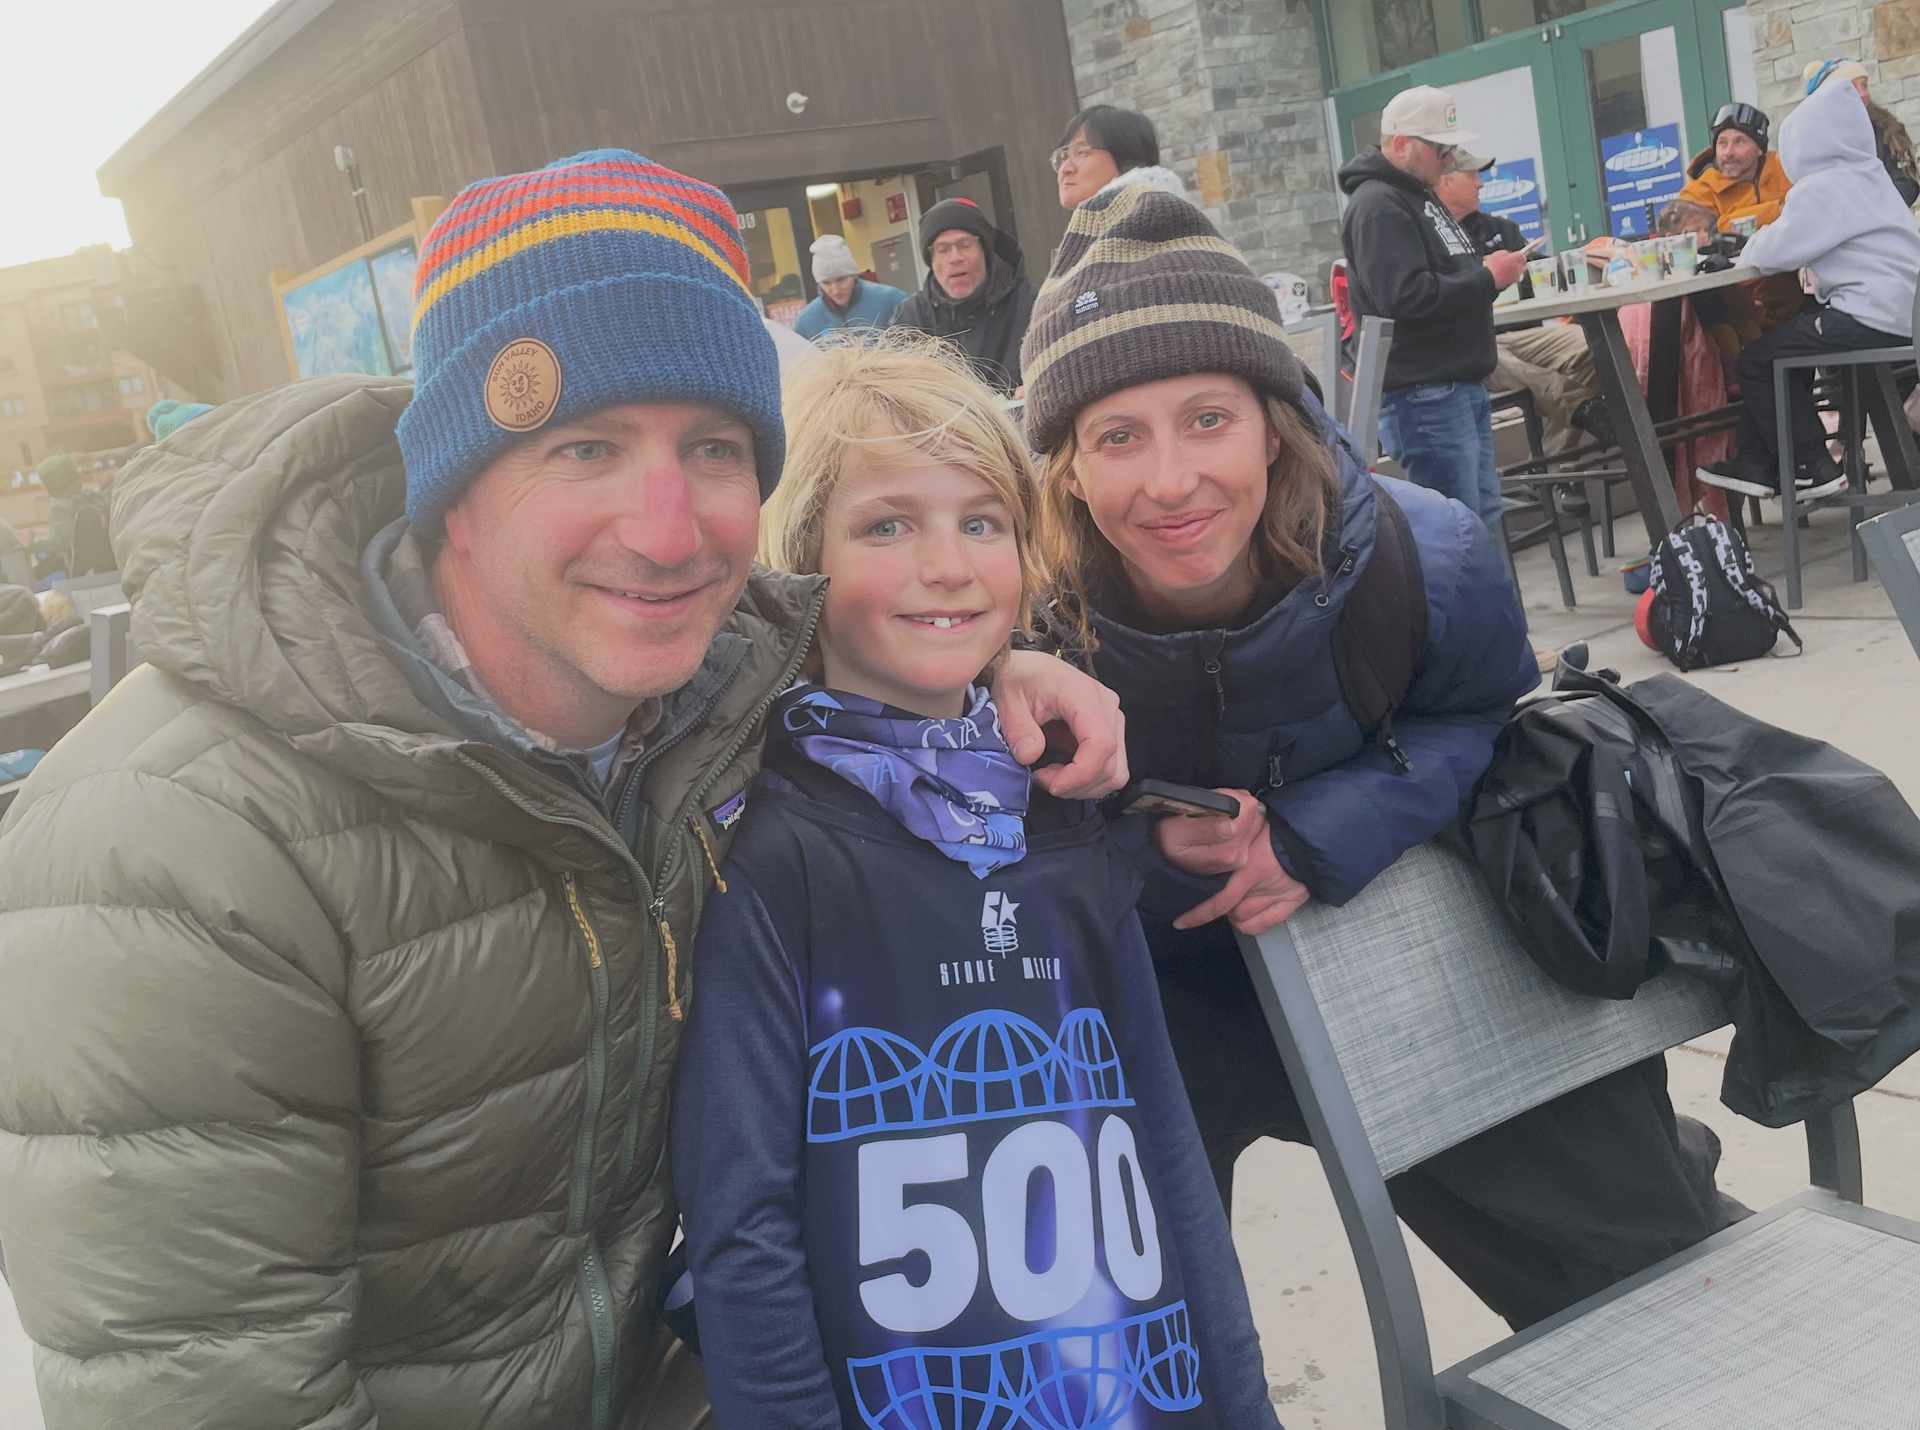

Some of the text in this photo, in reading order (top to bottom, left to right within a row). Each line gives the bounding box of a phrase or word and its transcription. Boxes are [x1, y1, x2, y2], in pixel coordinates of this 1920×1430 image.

[492, 347, 538, 383] SUN VALLEY
[515, 401, 545, 422] IDAHO
[783, 706, 837, 731] CV
[939, 959, 996, 986] STOKE
[858, 1113, 1163, 1333] 500
